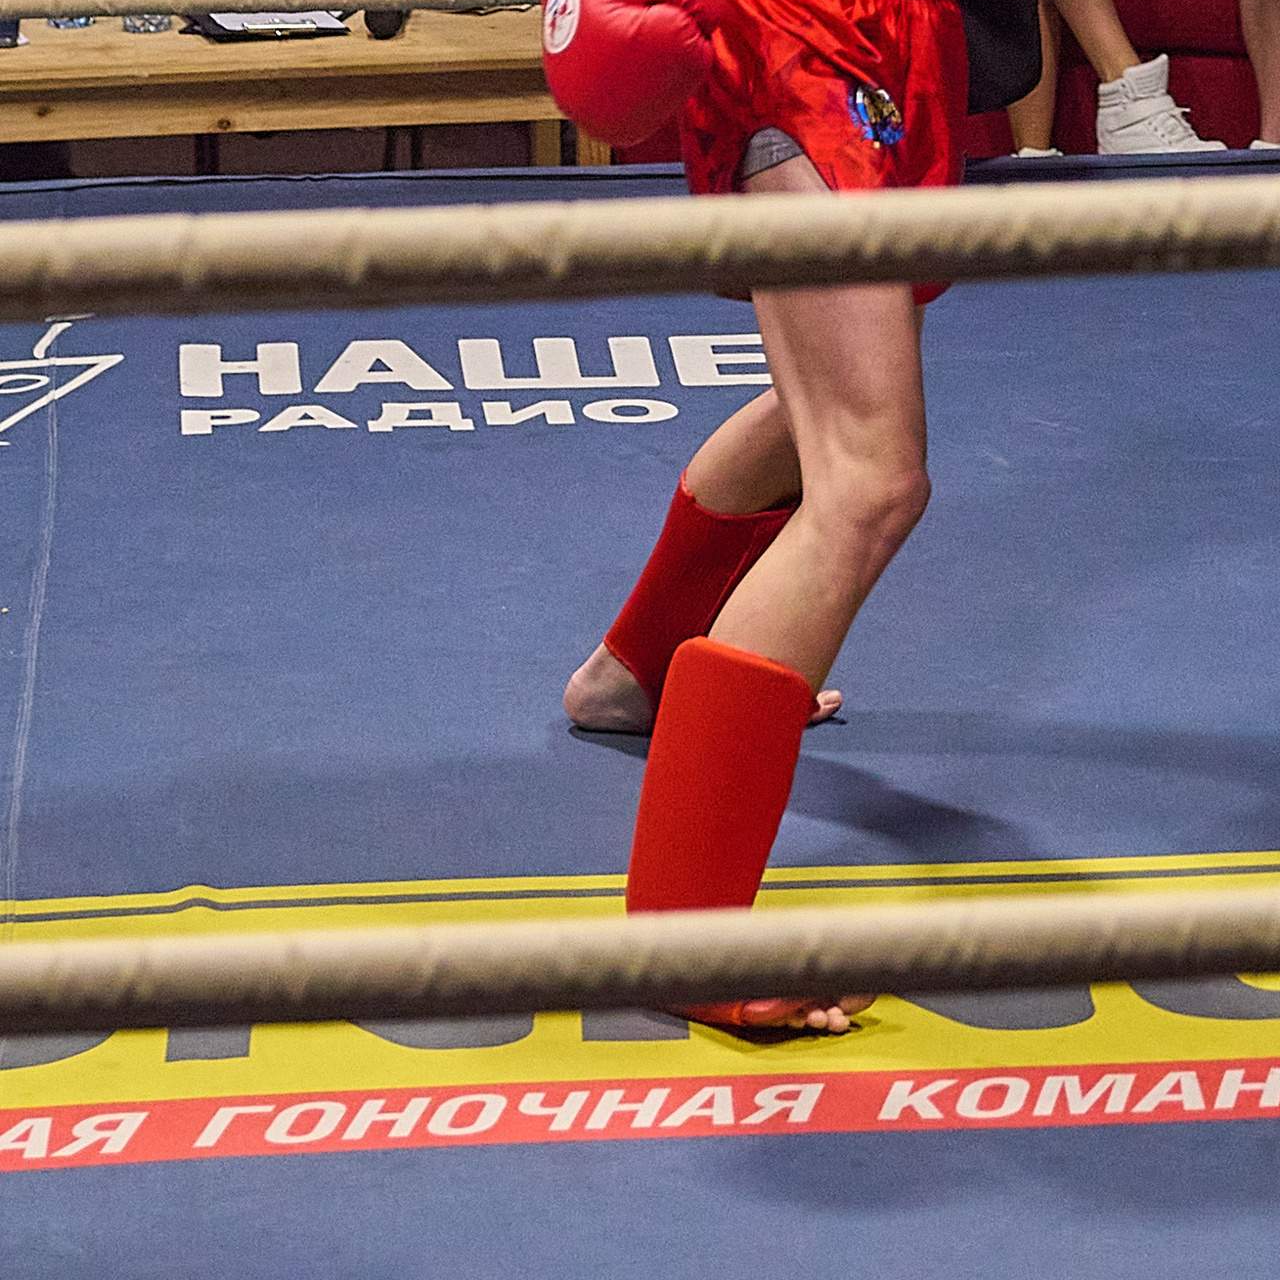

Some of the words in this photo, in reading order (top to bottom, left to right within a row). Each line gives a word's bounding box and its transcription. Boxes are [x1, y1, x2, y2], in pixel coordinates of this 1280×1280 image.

[179, 333, 774, 397] НАШЕ
[181, 398, 679, 435] РАДИО
[193, 1082, 826, 1148] ГОНОЧНАЯ
